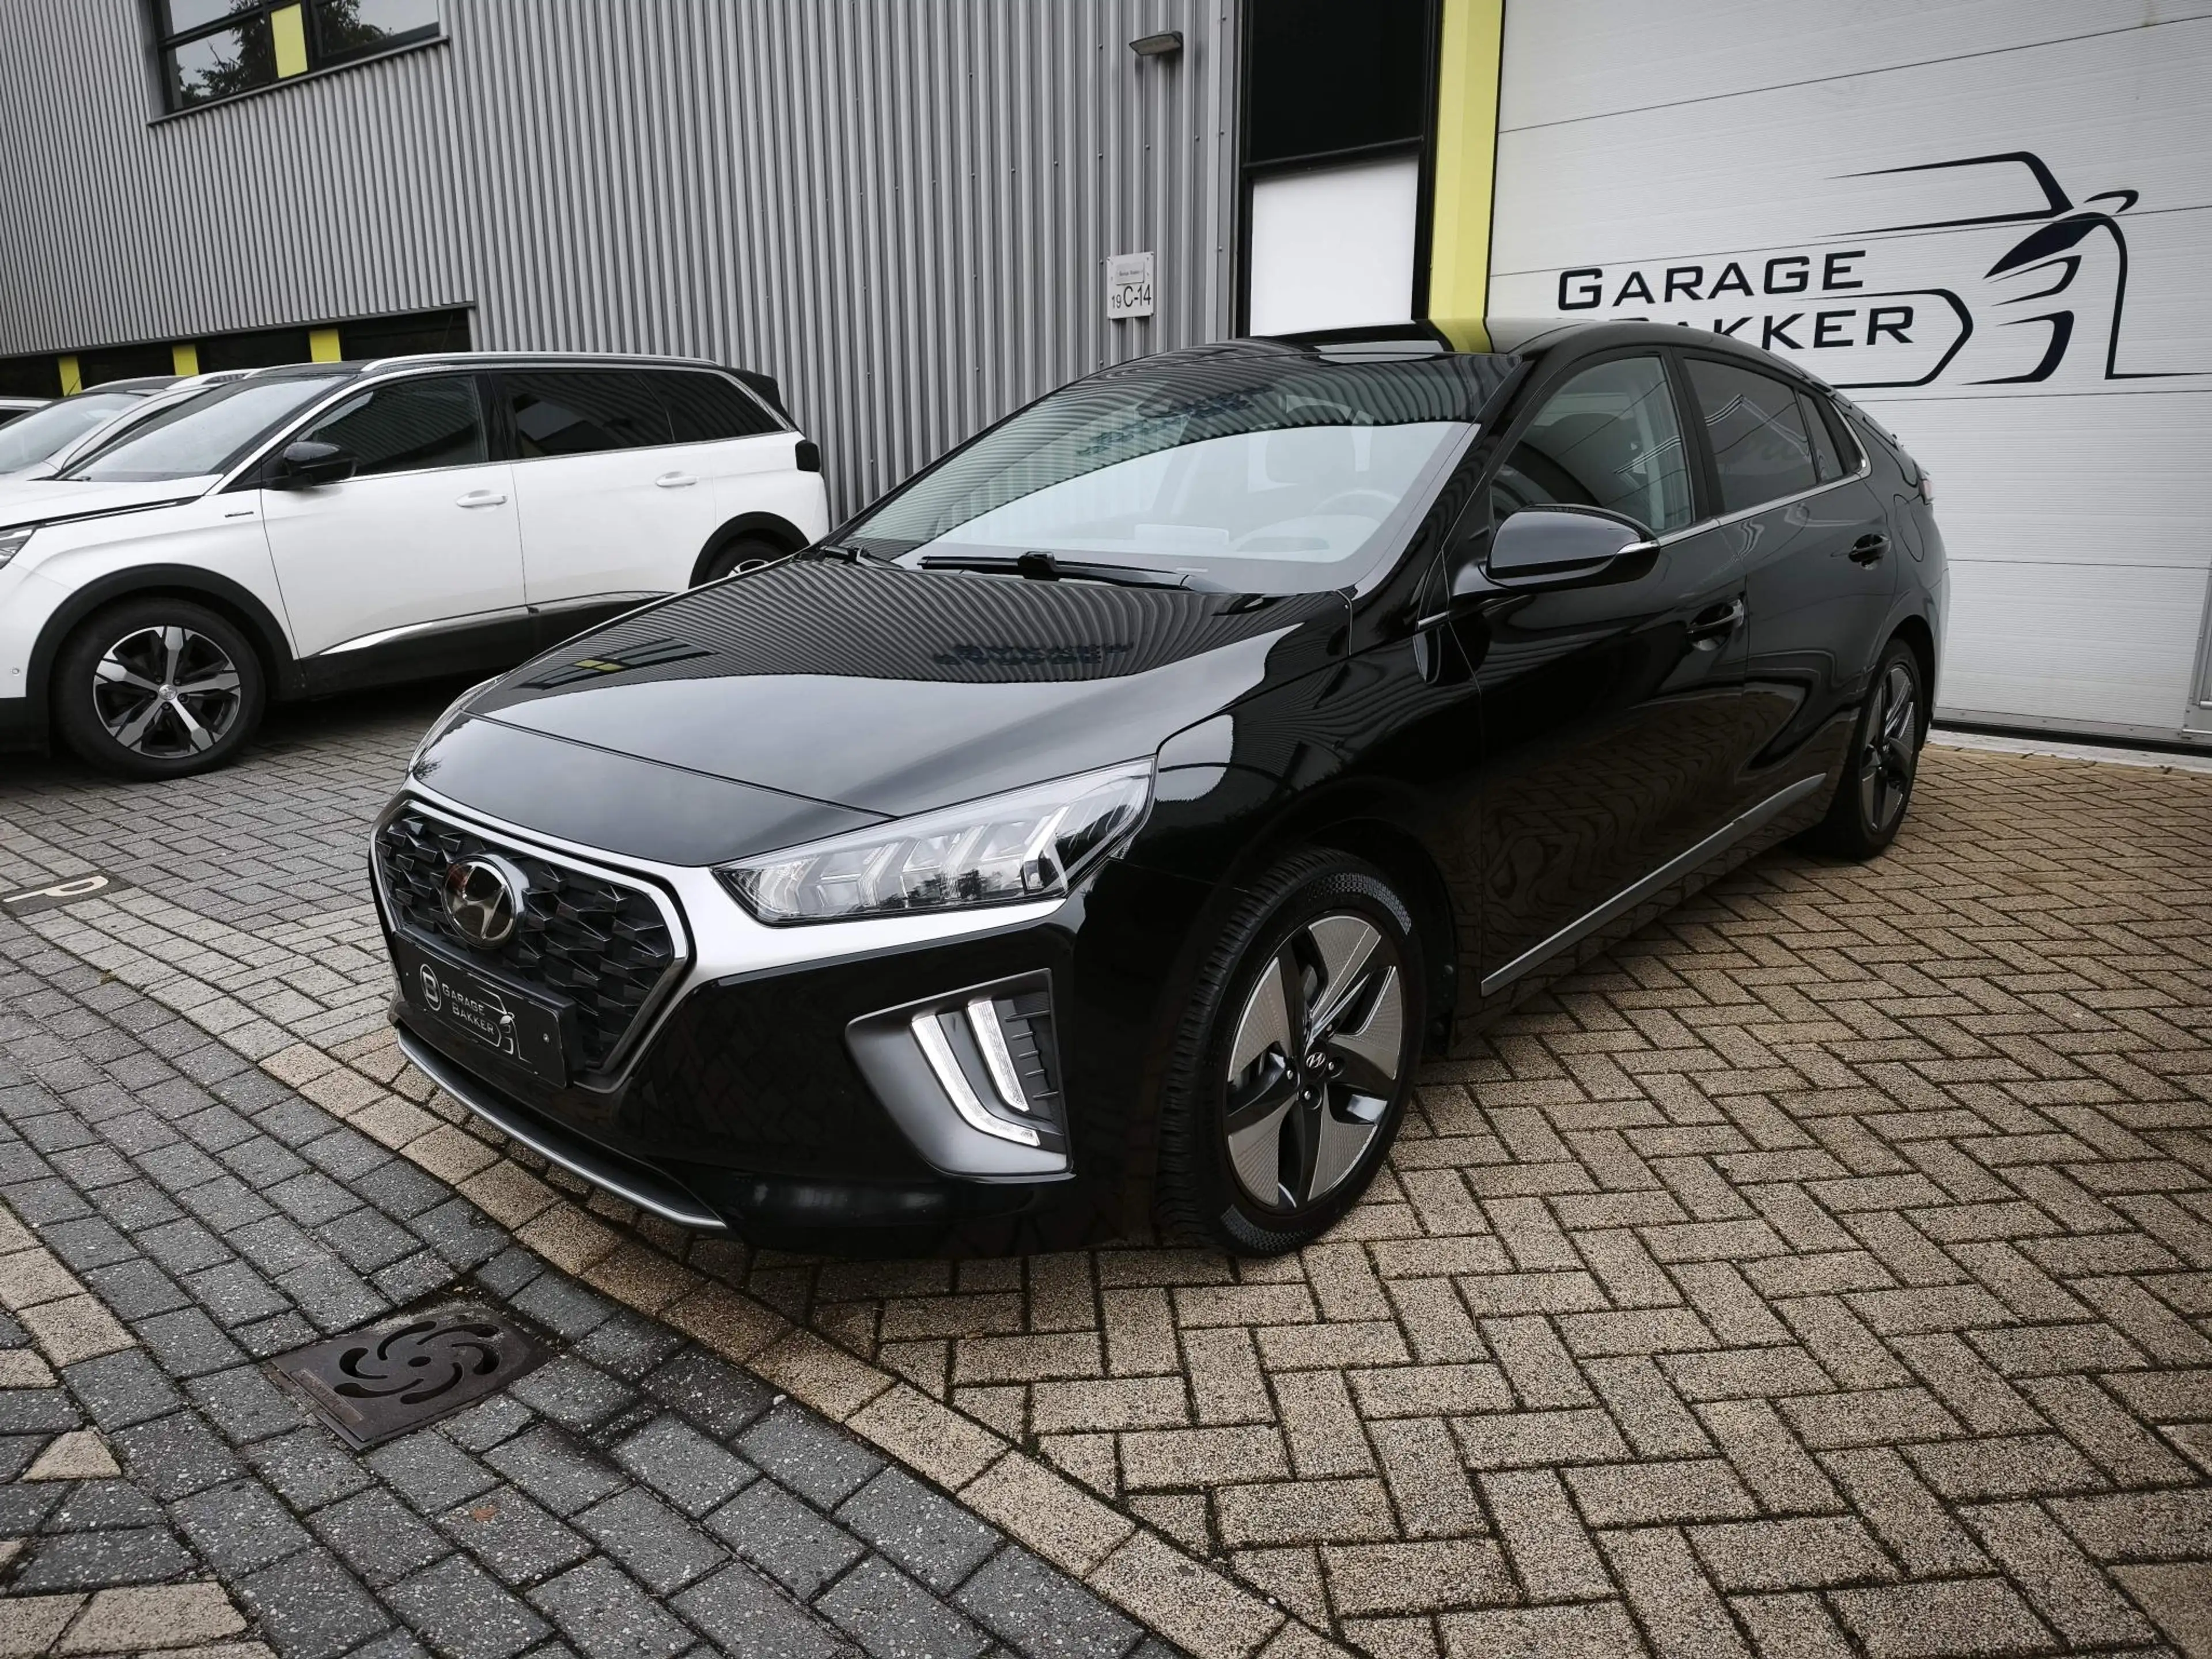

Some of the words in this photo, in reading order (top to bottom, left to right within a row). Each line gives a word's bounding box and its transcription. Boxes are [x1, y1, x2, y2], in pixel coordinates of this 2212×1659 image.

[1123, 284, 1152, 307] C-14
[1558, 249, 1867, 310] GARAGE
[1610, 306, 1915, 351] KKER
[441, 983, 485, 1016] GARAGE
[452, 1002, 495, 1035] BAKKER
